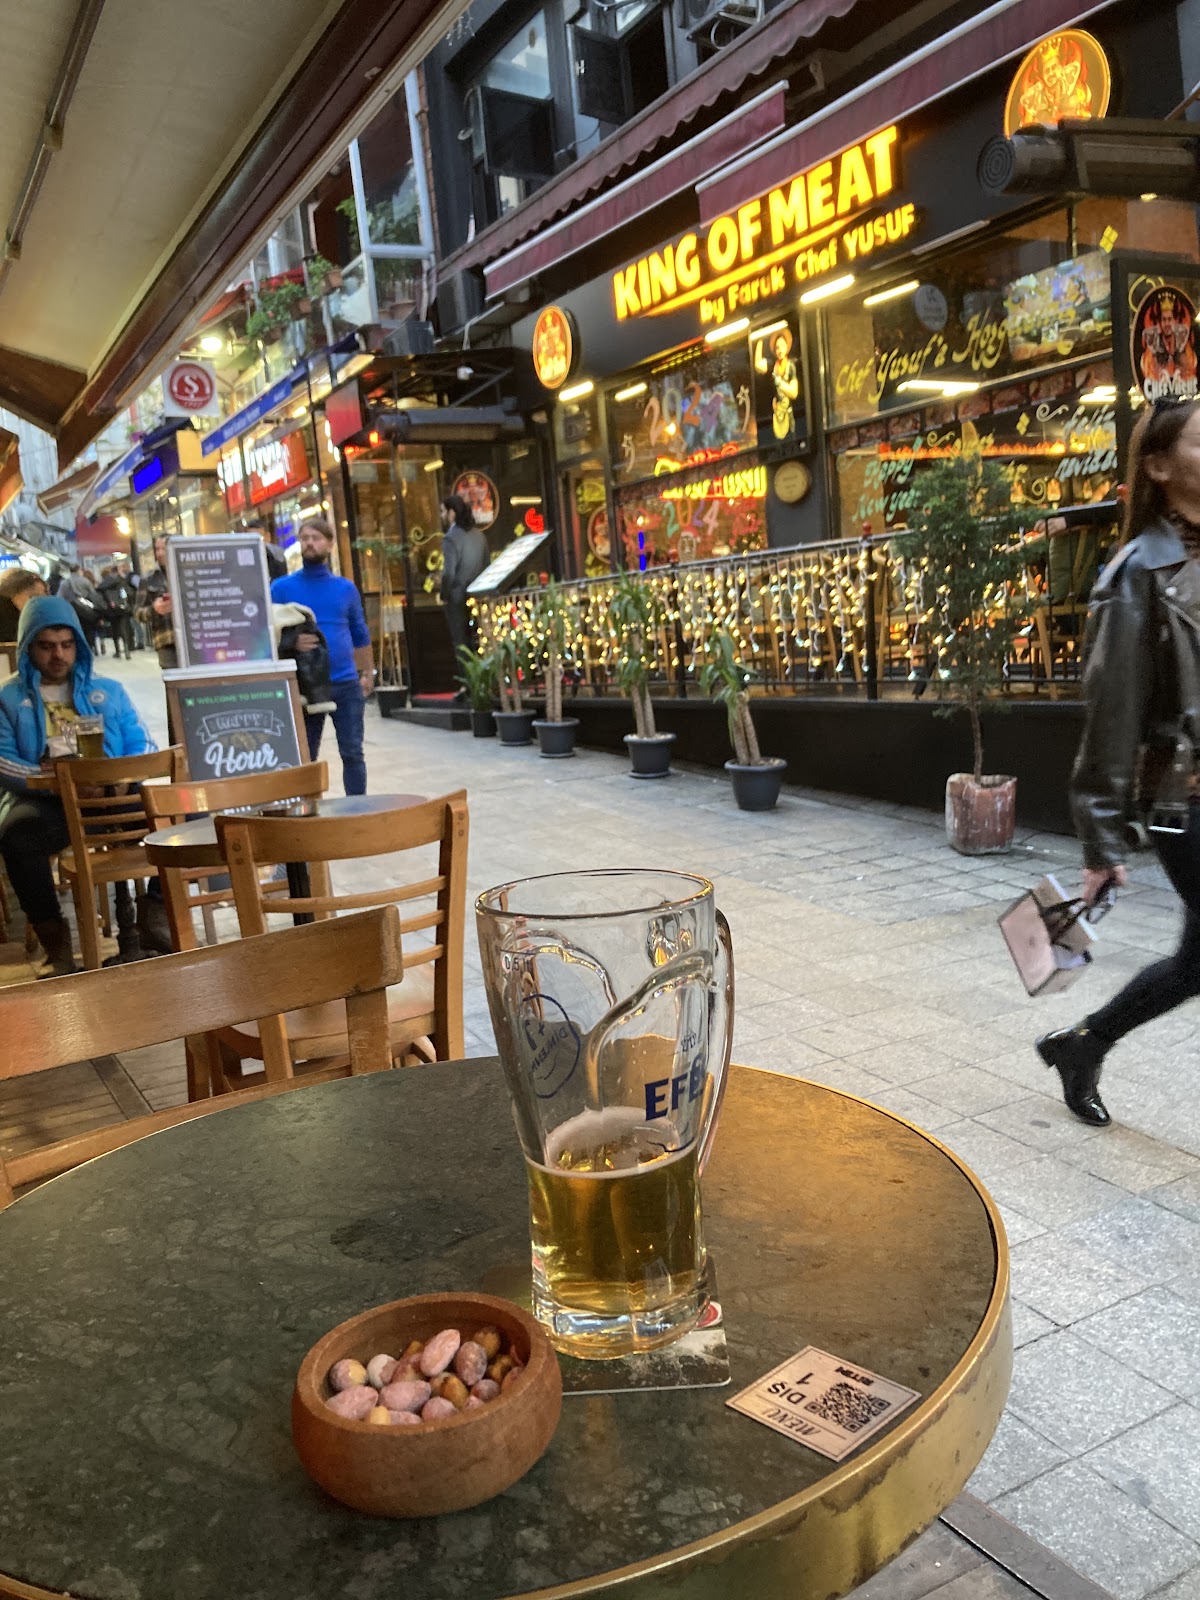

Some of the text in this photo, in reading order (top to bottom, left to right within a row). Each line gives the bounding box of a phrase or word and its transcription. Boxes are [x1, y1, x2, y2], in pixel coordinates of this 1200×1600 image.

[612, 125, 898, 321] KING OF MEAT
[700, 203, 916, 323] by Faruk Chef YUSUF
[180, 550, 225, 562] PARTY LIST
[205, 741, 279, 778] Hour
